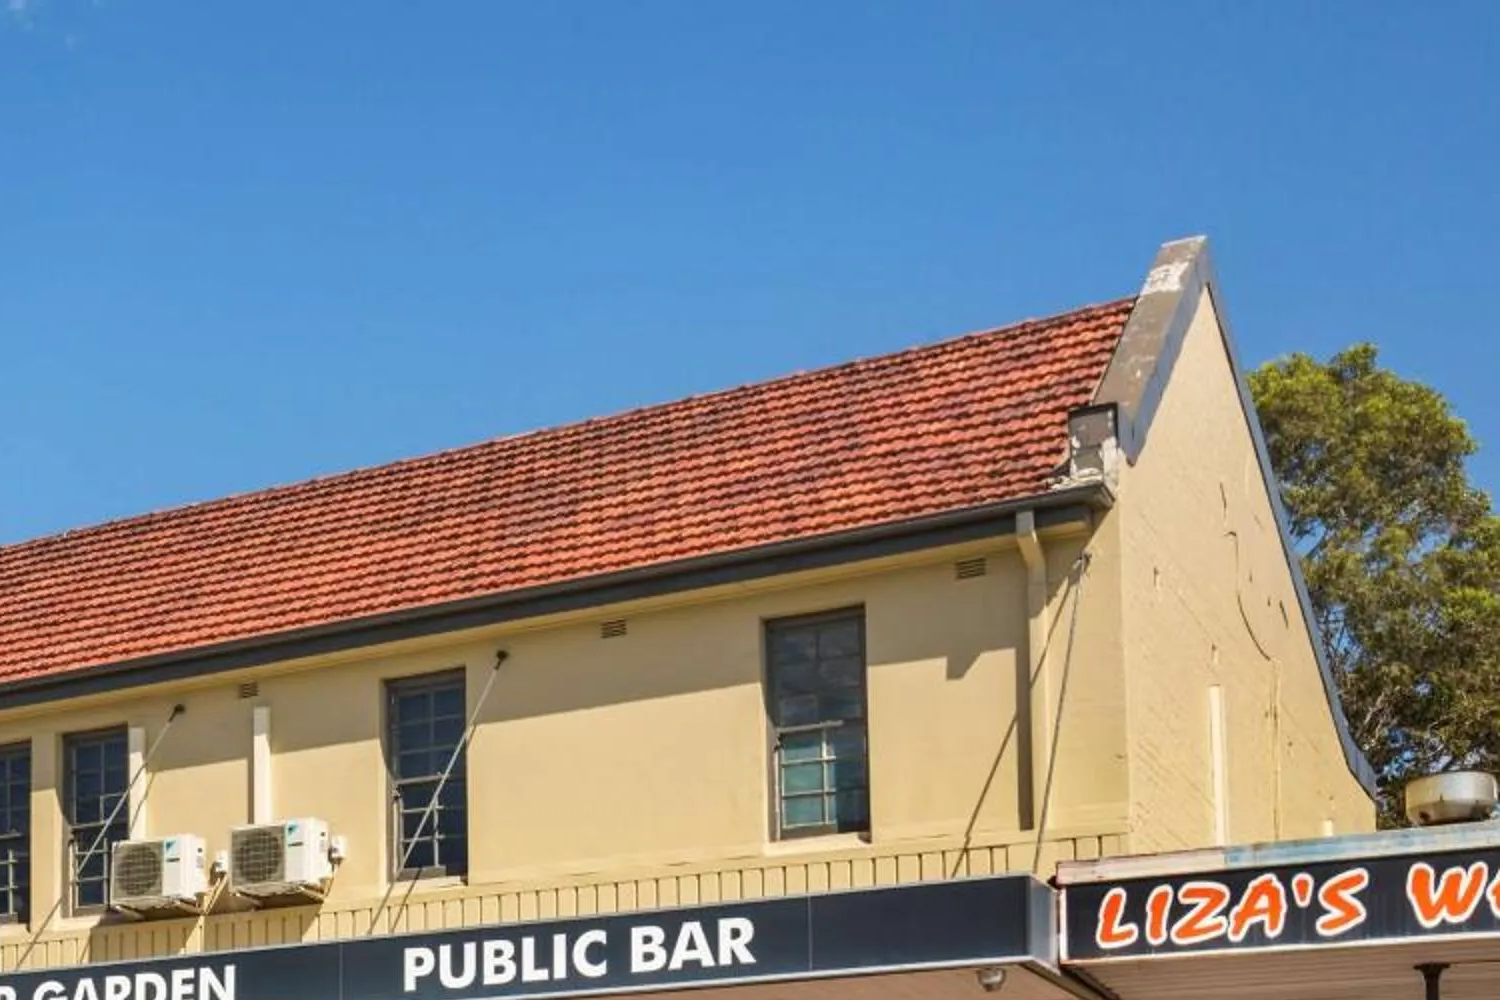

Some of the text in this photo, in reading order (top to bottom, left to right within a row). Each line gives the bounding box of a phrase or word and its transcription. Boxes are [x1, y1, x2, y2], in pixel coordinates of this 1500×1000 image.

[1096, 861, 1500, 950] LIZA'S W
[402, 916, 757, 993] PUBLIC BAR
